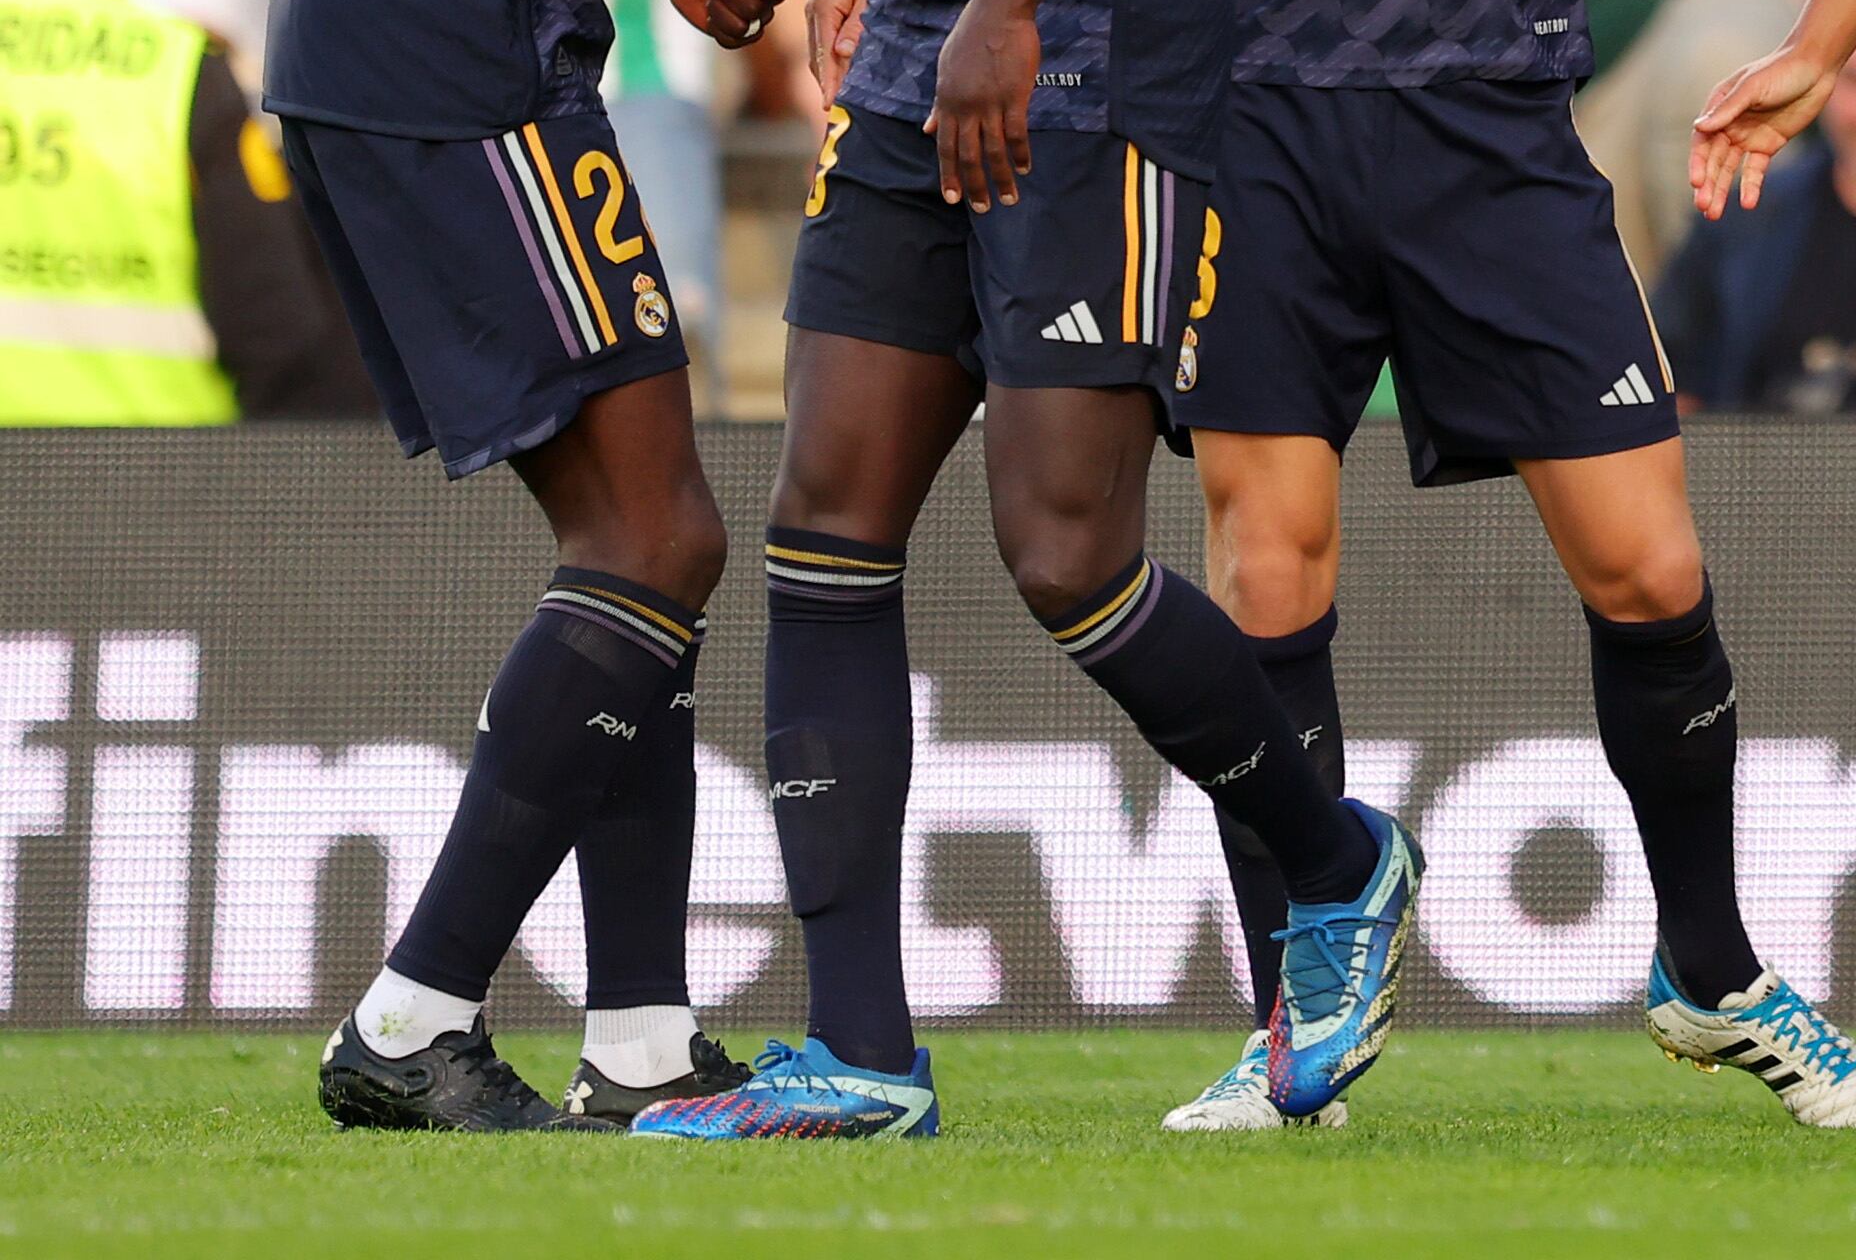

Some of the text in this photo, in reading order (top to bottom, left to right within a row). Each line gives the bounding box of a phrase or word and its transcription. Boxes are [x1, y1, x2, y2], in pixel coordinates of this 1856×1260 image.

[1035, 73, 1082, 87] EAT.RDY
[573, 150, 650, 265] 2
[769, 779, 837, 799] MCF
